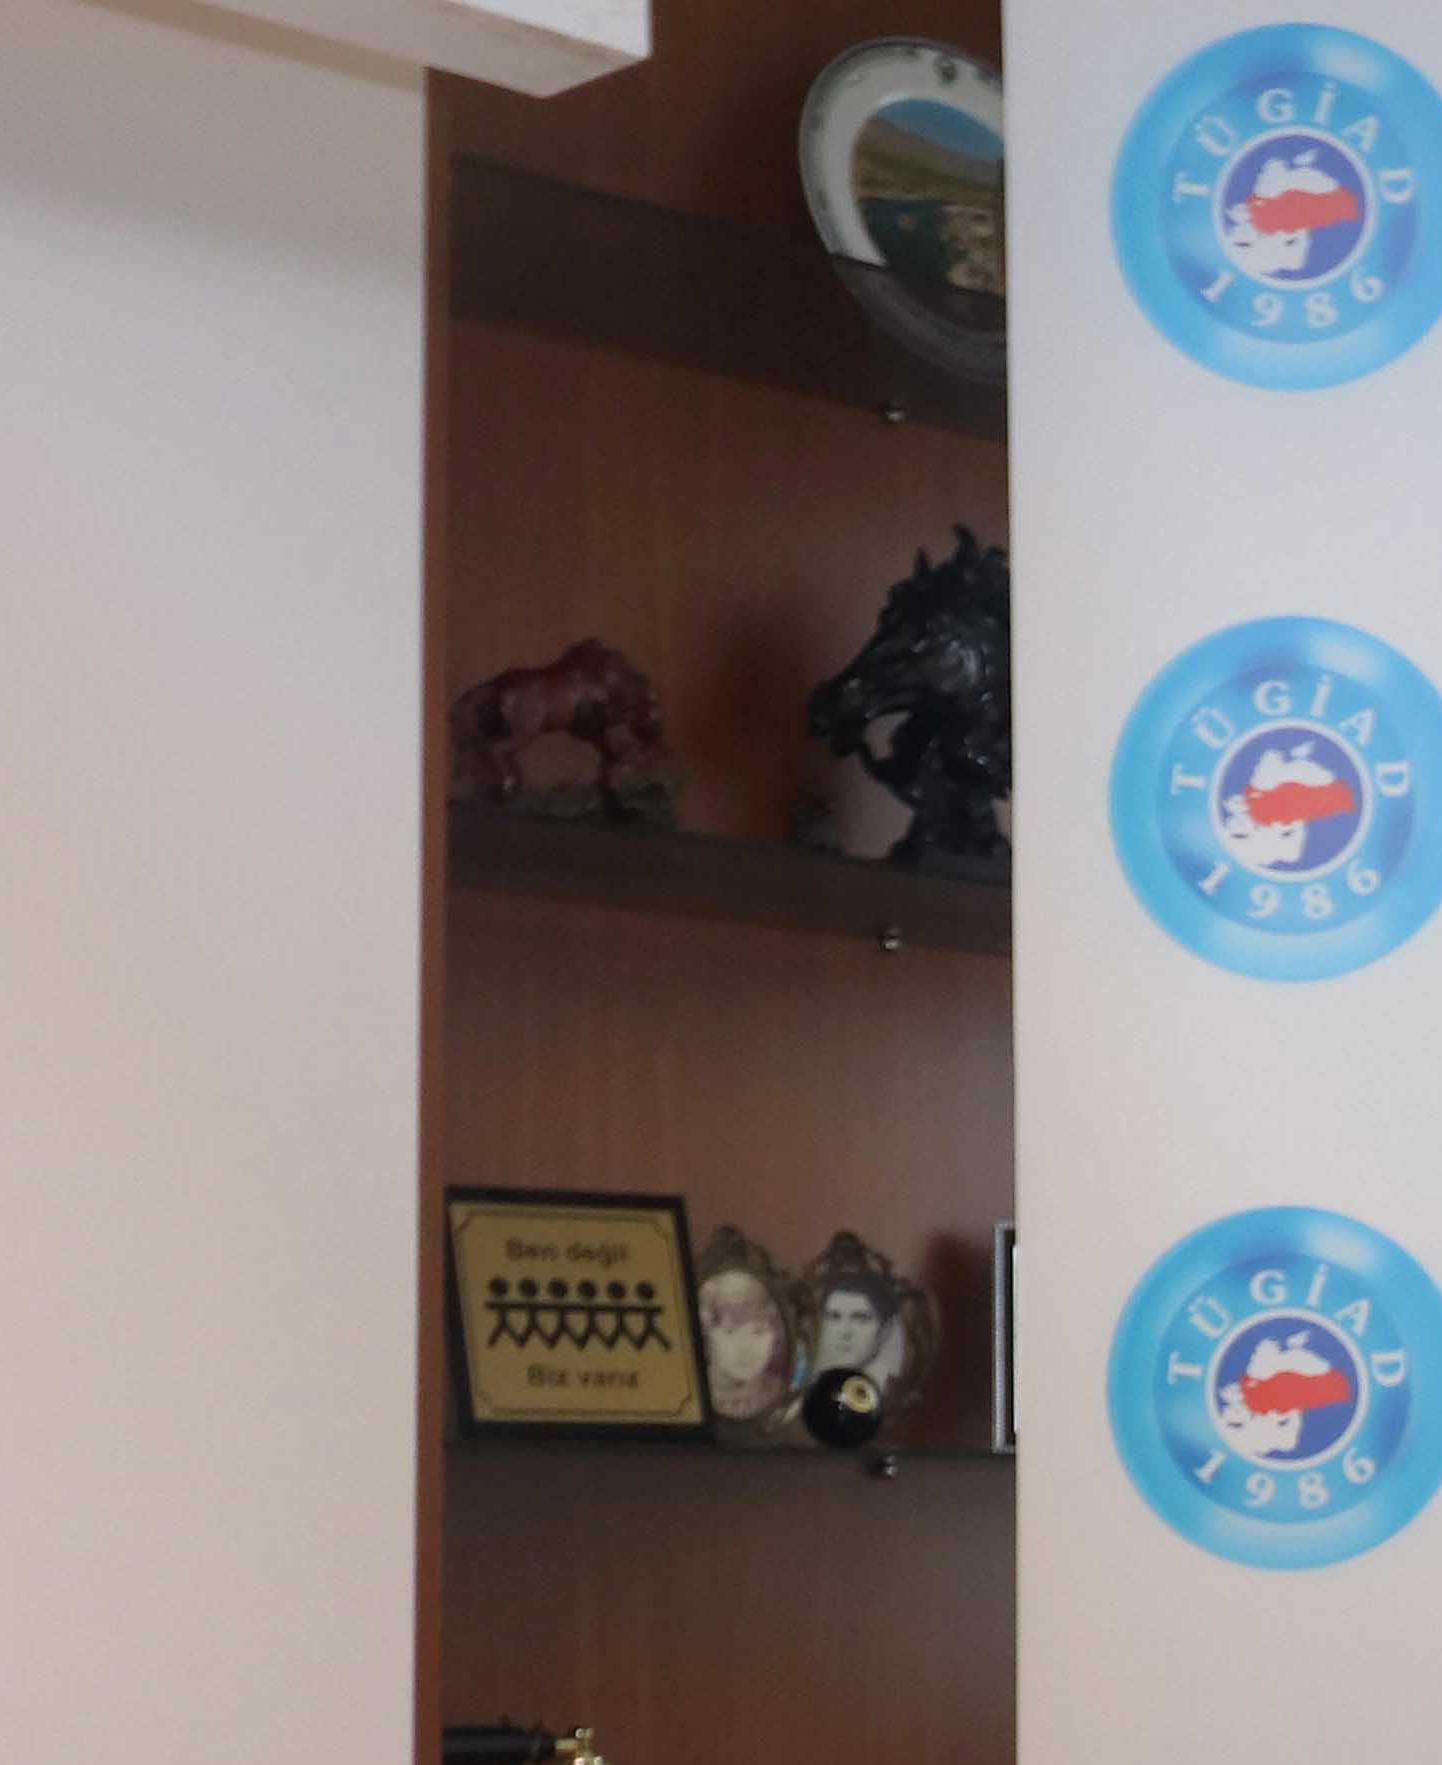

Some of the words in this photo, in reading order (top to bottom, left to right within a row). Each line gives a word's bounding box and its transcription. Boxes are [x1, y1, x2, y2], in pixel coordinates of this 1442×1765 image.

[1171, 82, 1415, 205] TÜGİAD
[1198, 265, 1385, 329] 1986
[1169, 675, 1410, 797] TÜGİAD
[1197, 860, 1382, 919] 1986
[1166, 1262, 1406, 1388] TÜGİAD
[1196, 1448, 1377, 1510] 1986
